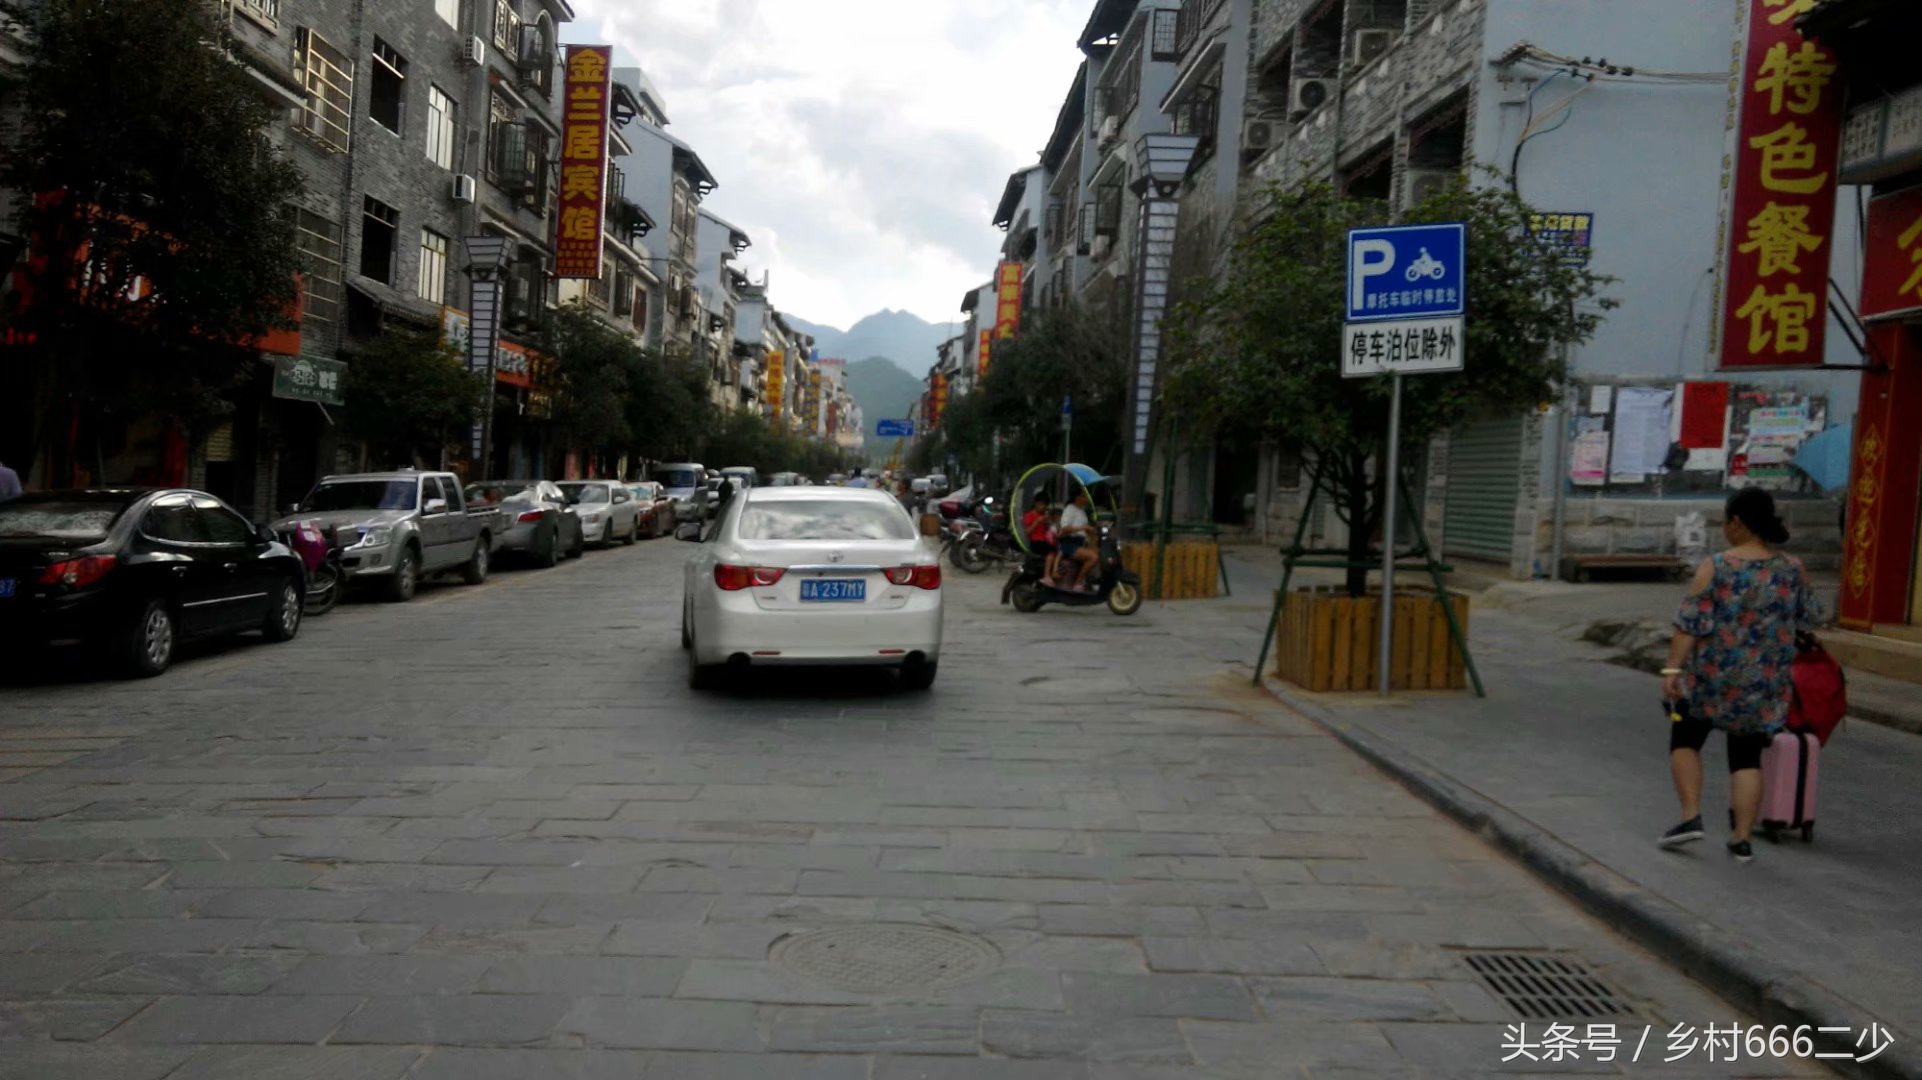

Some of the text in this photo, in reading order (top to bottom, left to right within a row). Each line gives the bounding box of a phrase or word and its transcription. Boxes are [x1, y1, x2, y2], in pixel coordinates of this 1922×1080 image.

[562, 48, 607, 241] 金兰居宾馆
[1352, 238, 1396, 310] P
[1351, 326, 1456, 365] 停车泊位除外
